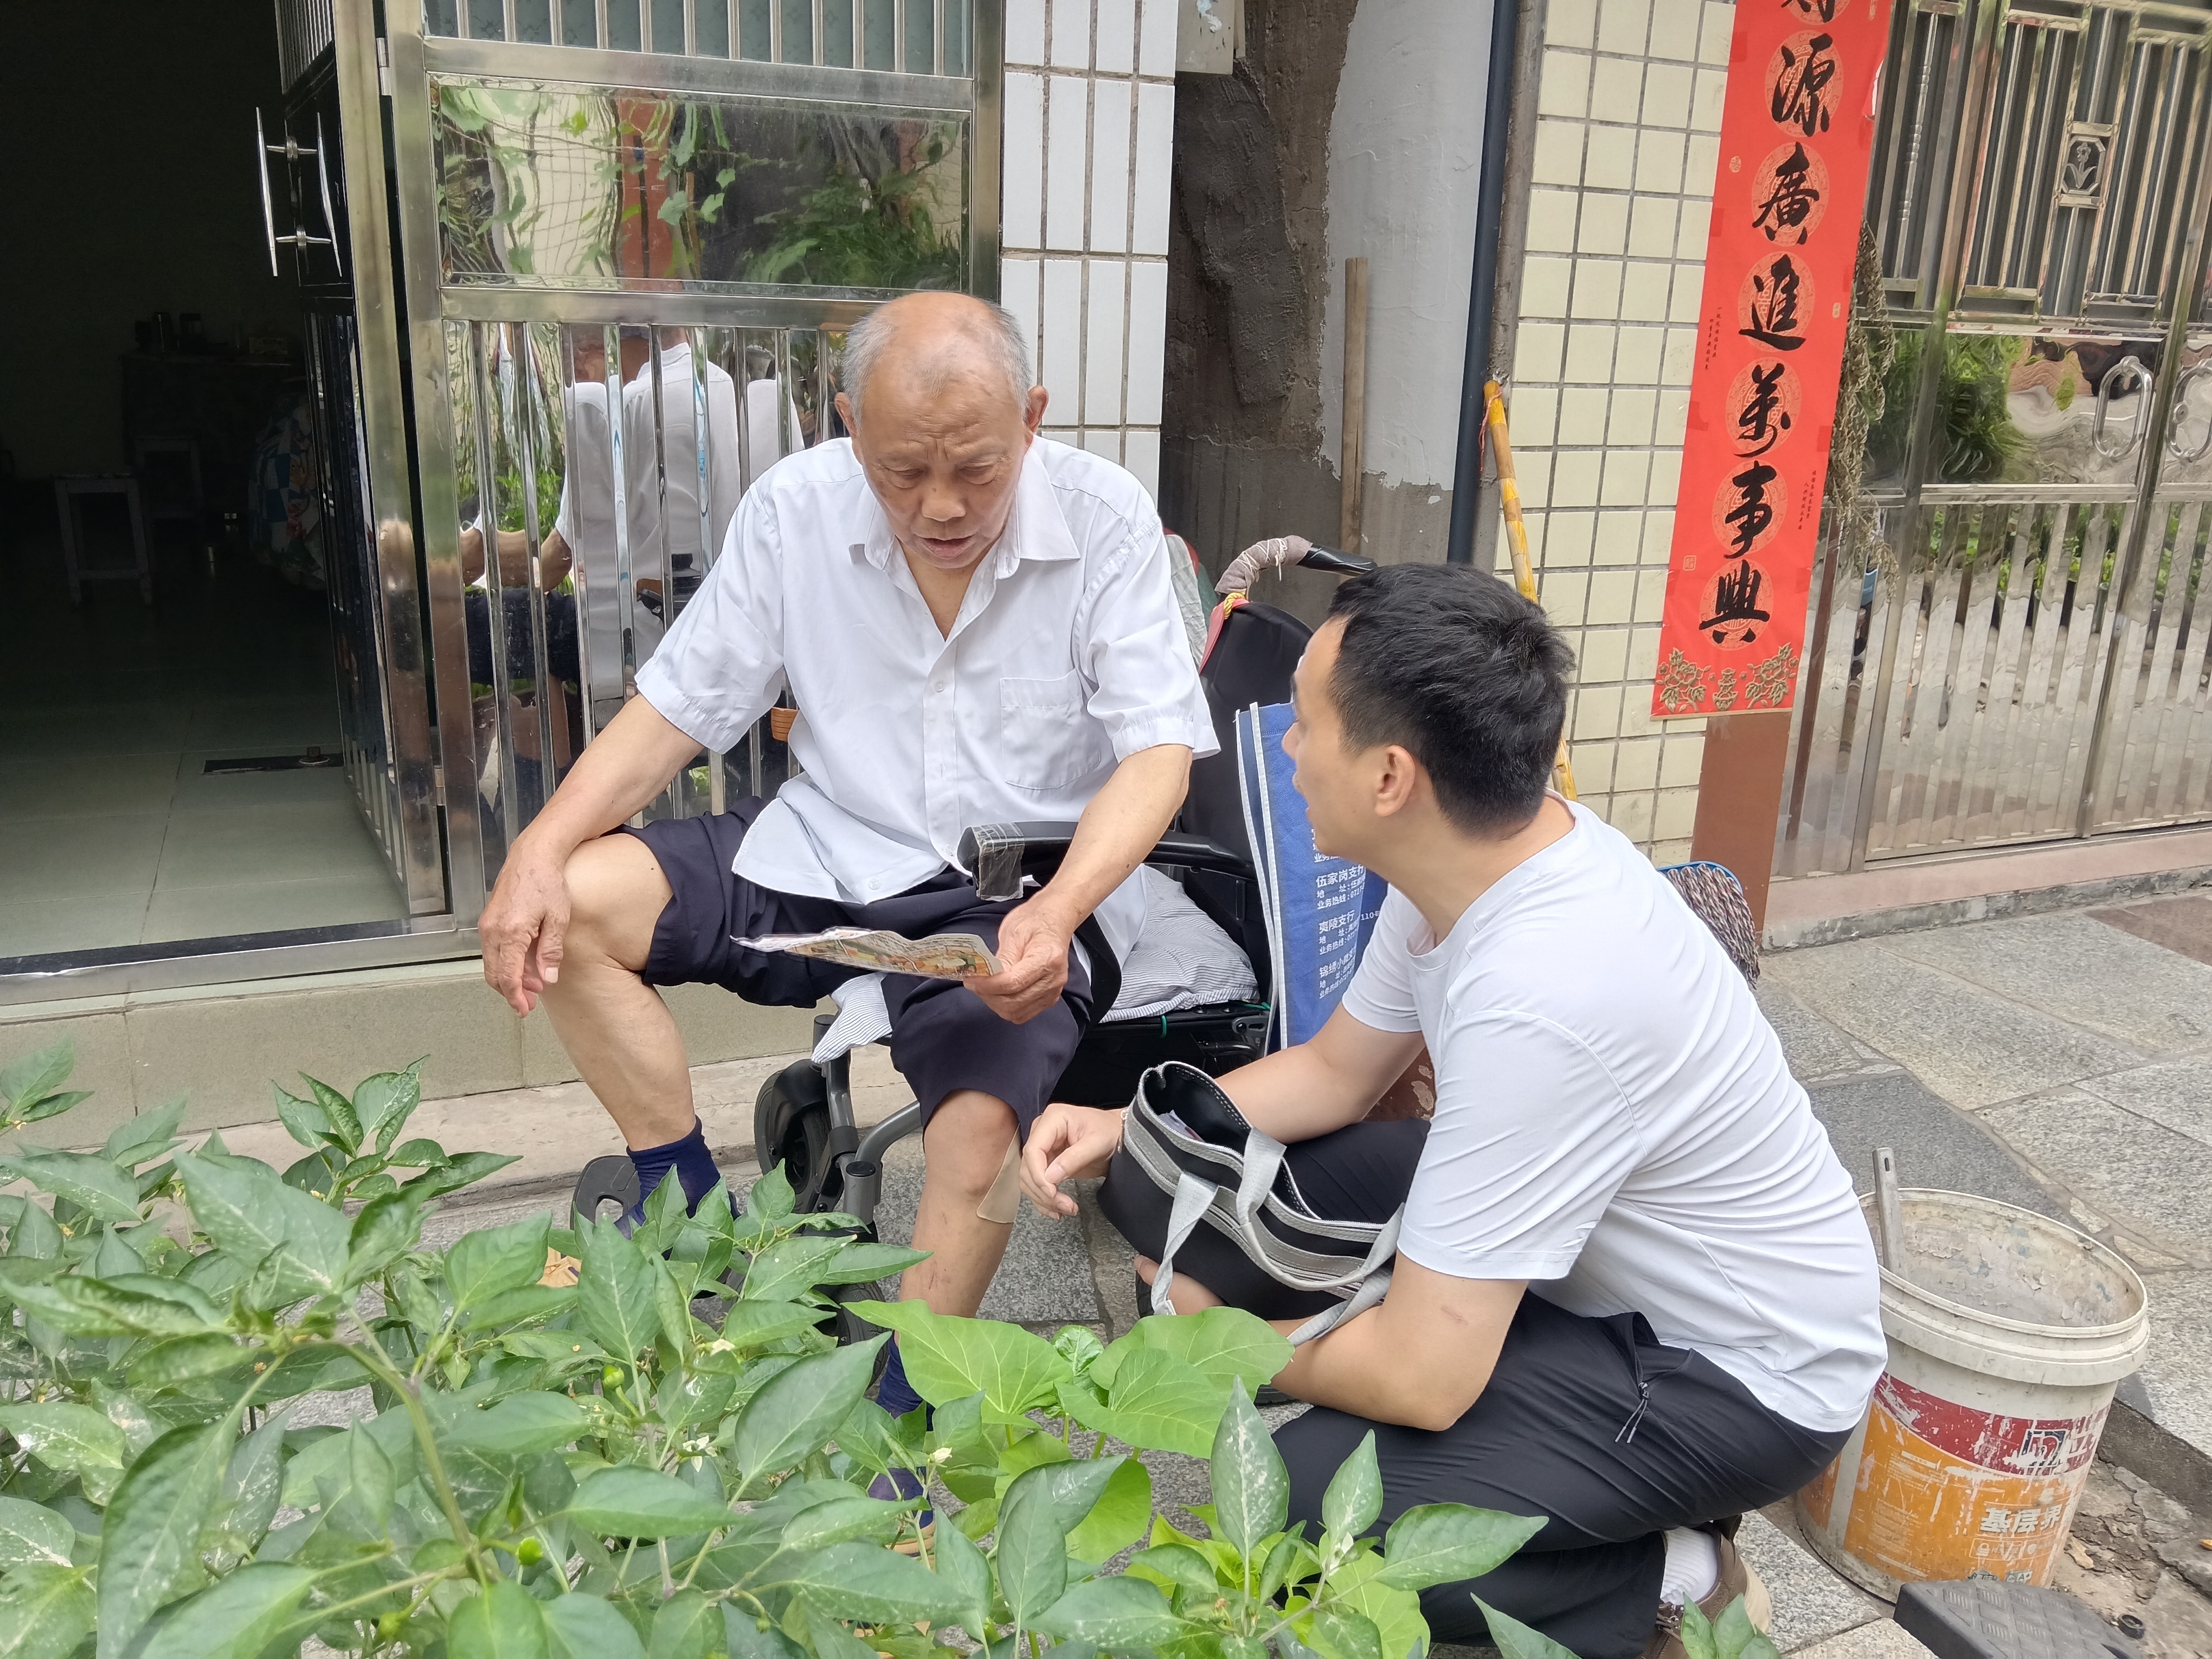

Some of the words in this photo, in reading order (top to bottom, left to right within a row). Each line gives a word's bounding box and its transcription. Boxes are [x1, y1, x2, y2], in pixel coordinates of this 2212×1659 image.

[1699, 0, 1835, 644] 源廣進萬事興
[1319, 910, 1355, 935] 夷陵支行
